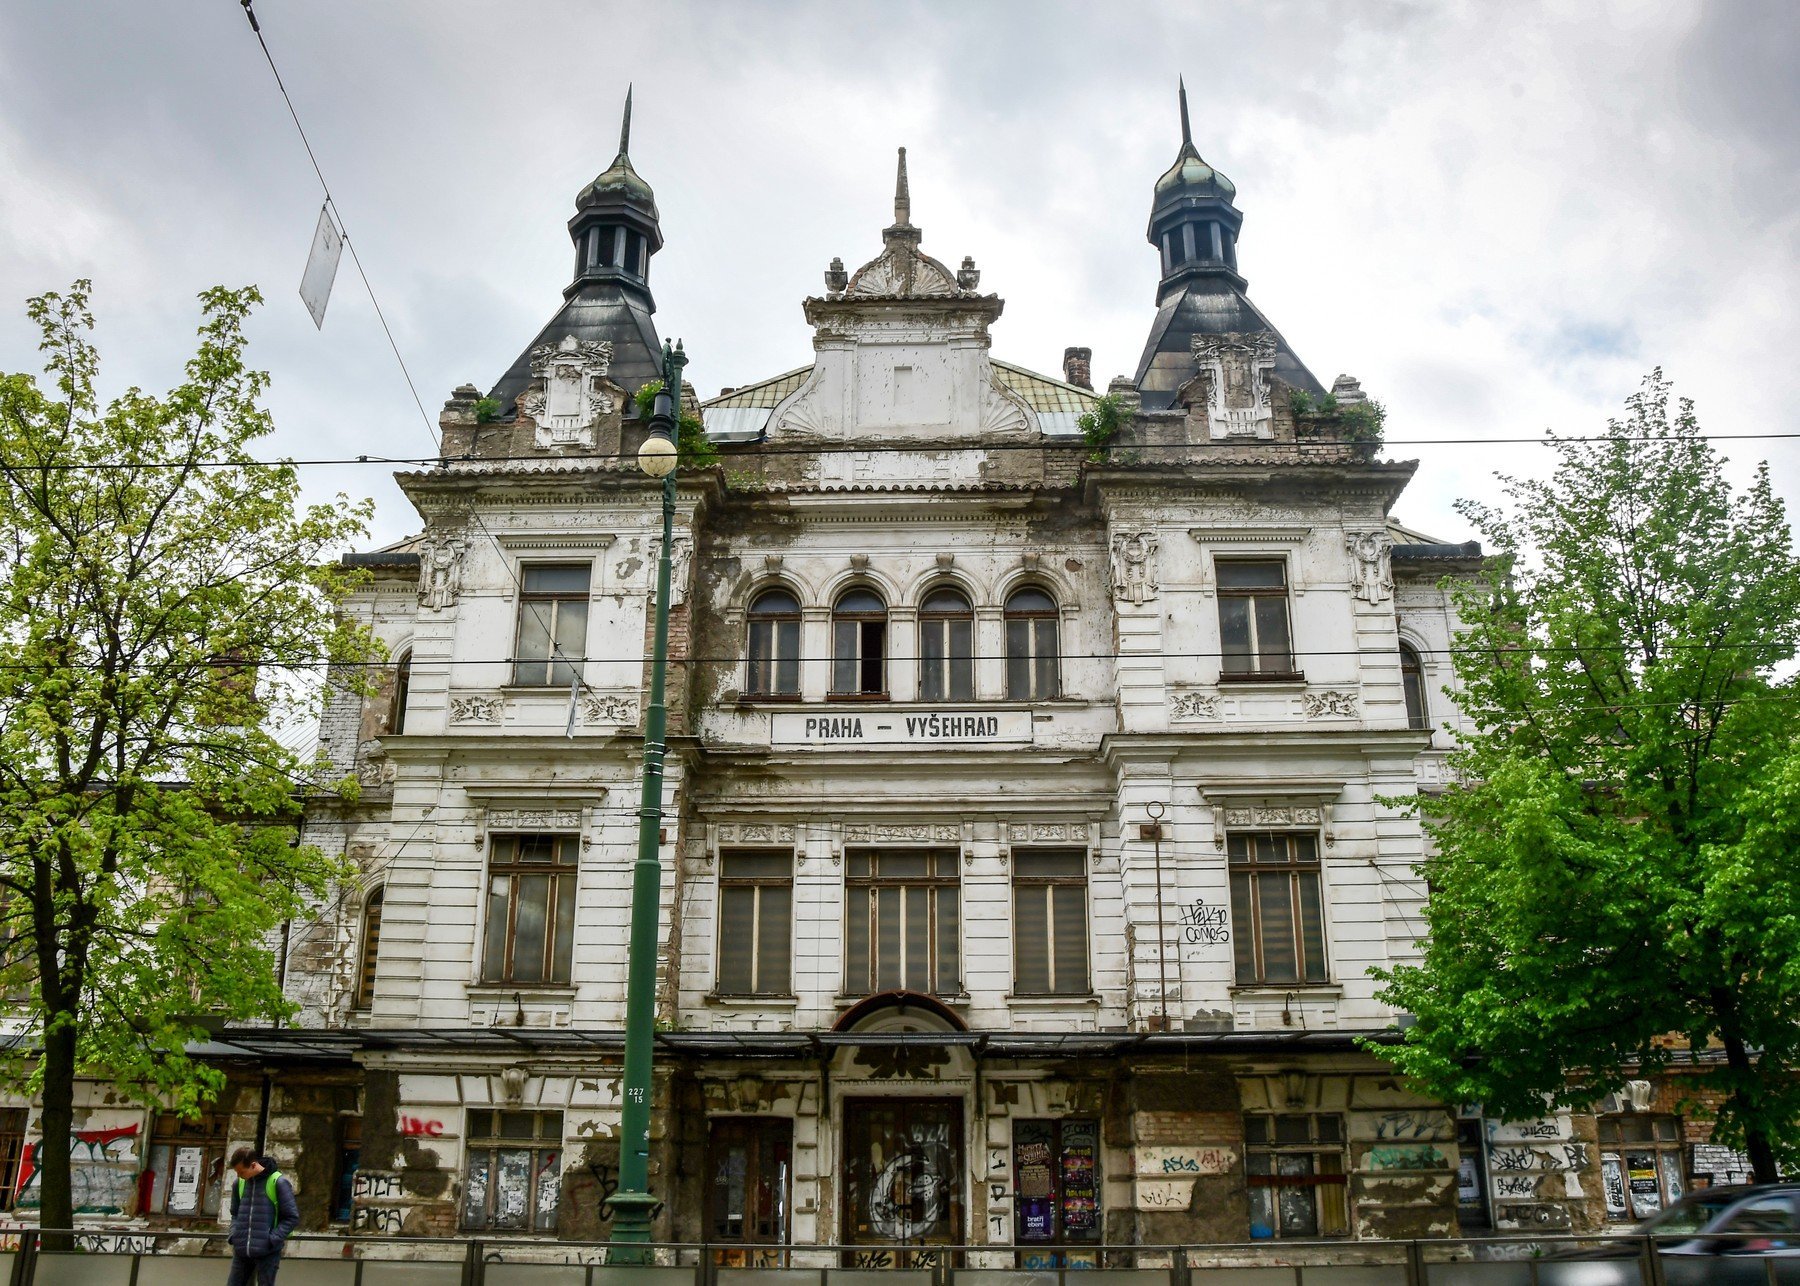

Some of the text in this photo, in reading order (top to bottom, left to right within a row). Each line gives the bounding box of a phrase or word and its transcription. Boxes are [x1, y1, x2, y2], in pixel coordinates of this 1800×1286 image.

[805, 718, 863, 738] PRAHA
[906, 714, 998, 738] VYŠEHRAD
[628, 1087, 644, 1096] 227
[634, 1096, 643, 1104] 15
